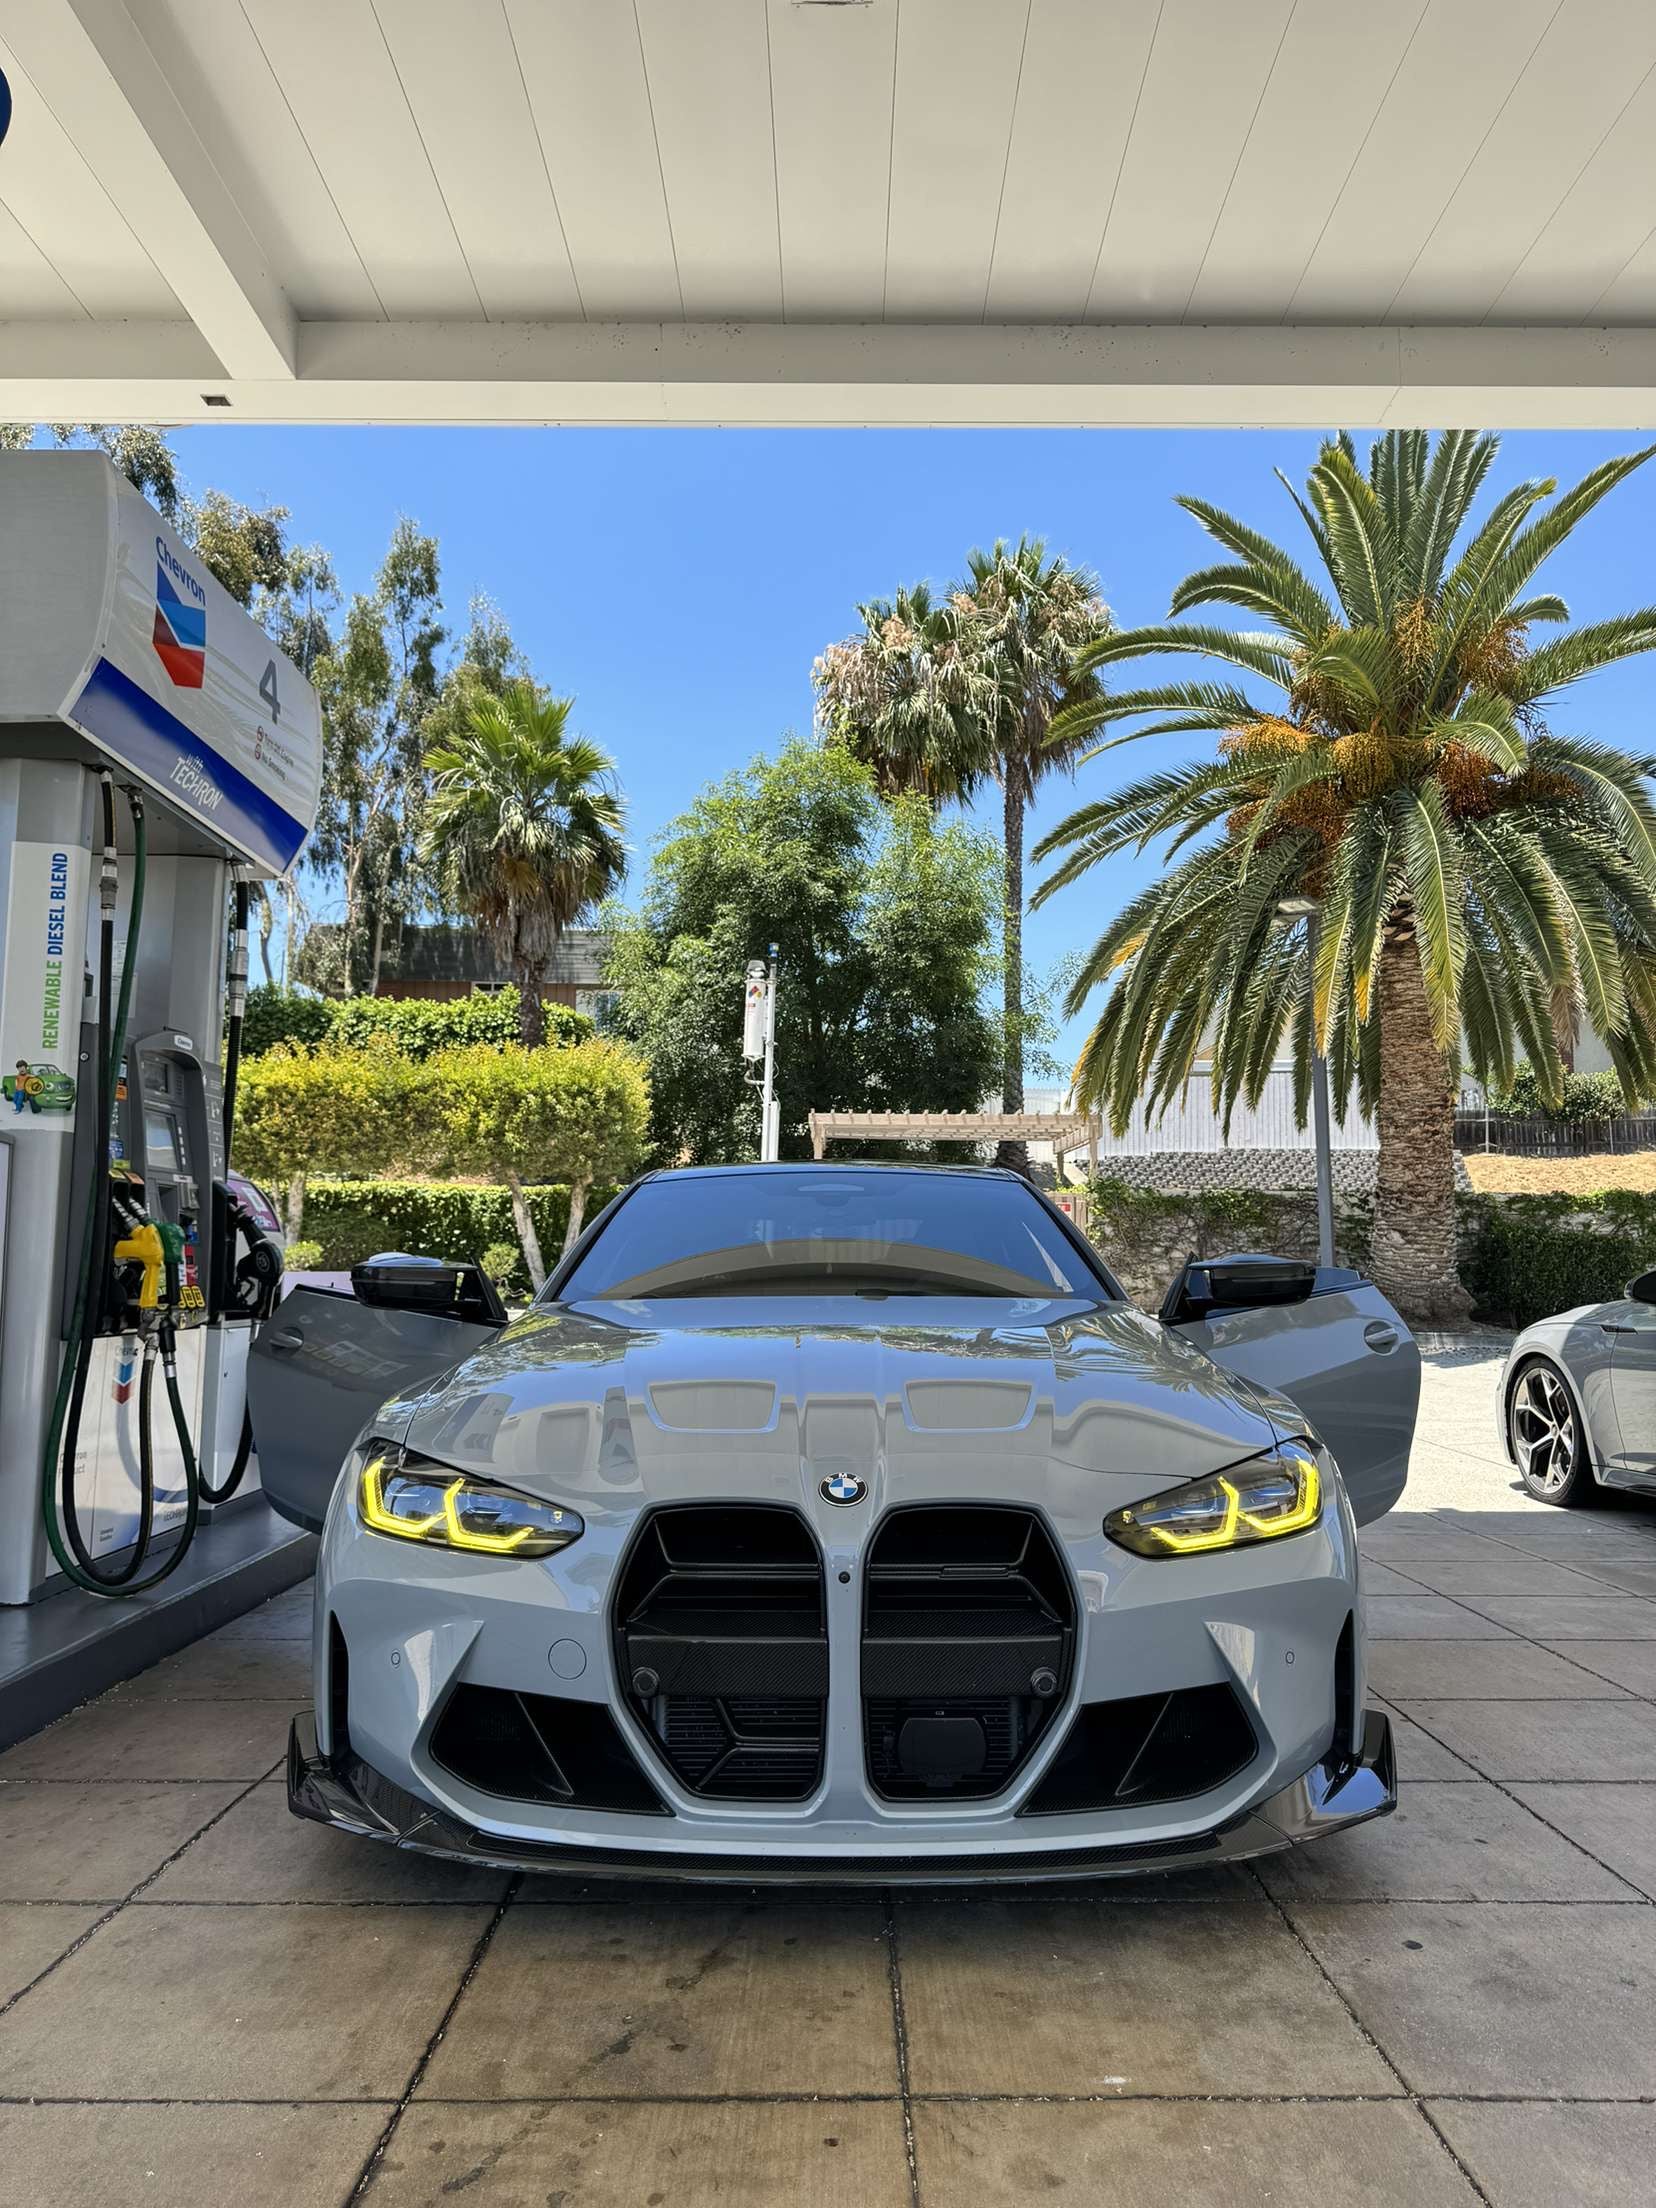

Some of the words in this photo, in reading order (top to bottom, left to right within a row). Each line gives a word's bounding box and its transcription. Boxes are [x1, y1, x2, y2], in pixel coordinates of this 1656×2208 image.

[156, 535, 206, 608] Chevron
[259, 659, 281, 725] 4
[170, 756, 224, 810] TECHRON
[50, 852, 68, 900] BLEND
[47, 905, 65, 955] DIESEL
[42, 960, 62, 1050] RENEWABLE
[824, 1472, 863, 1483] BMW
